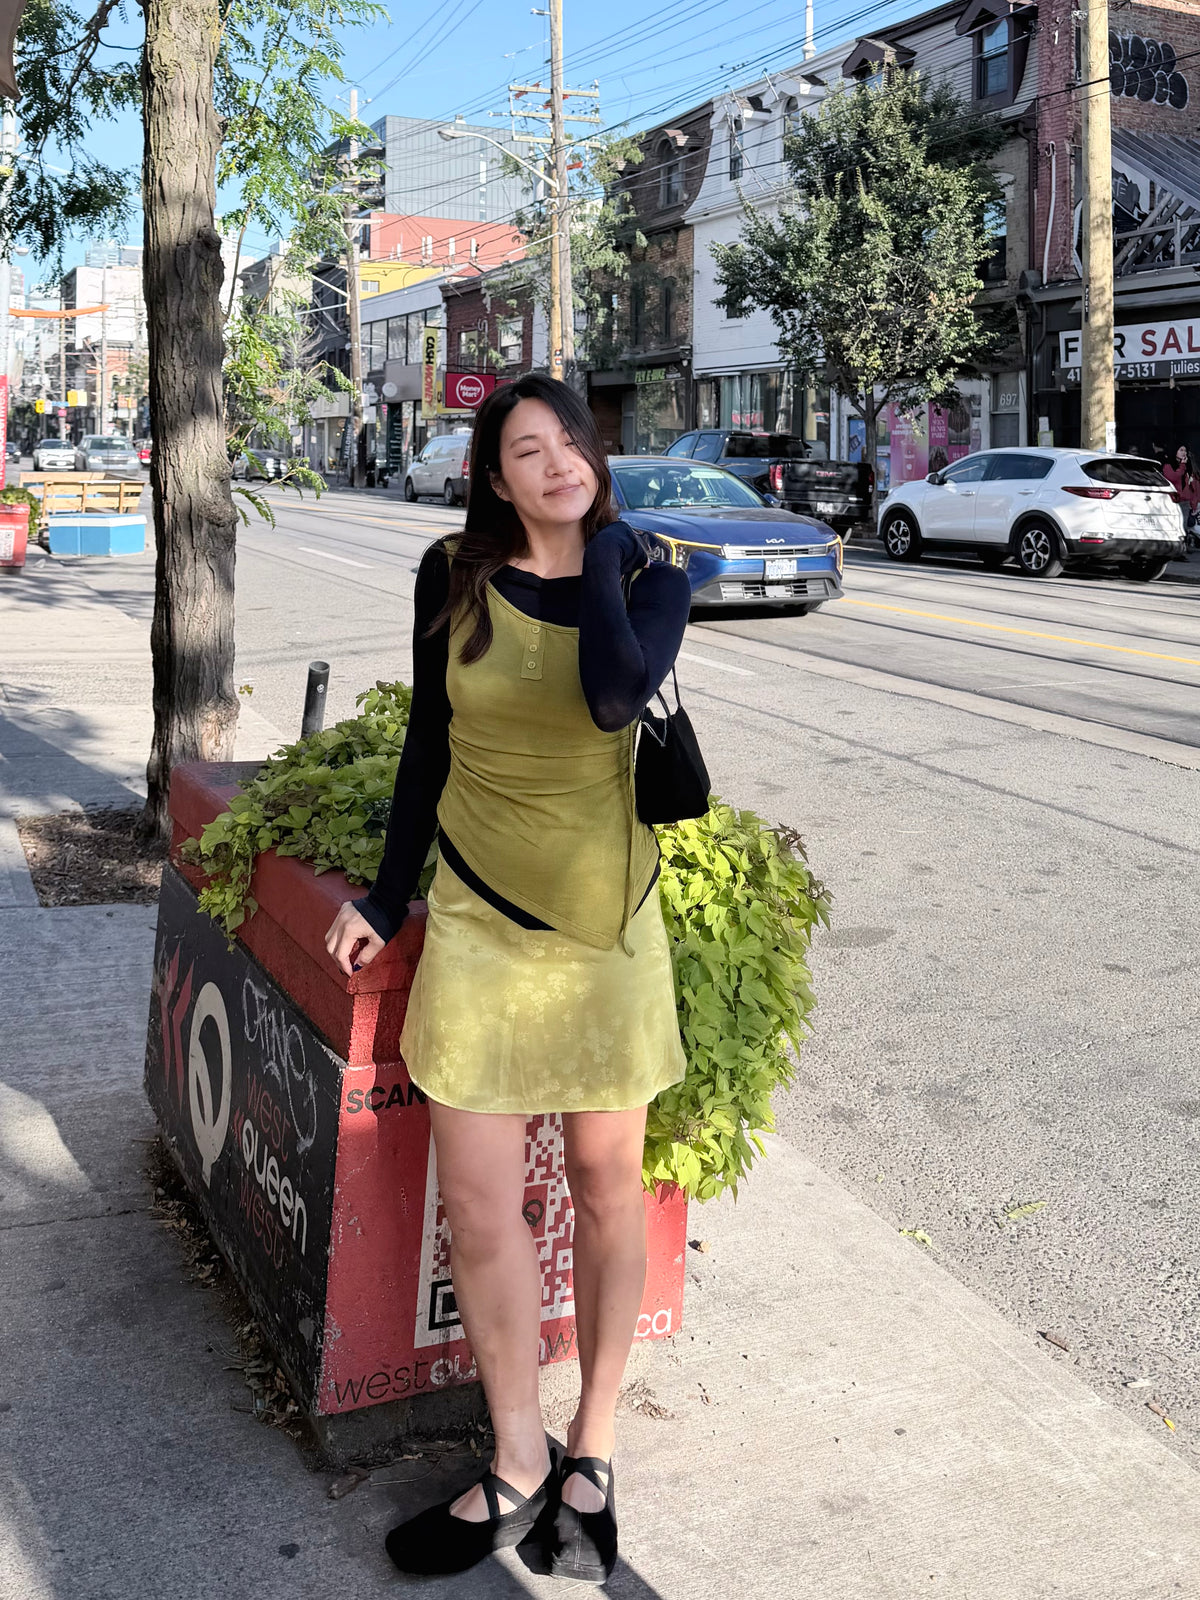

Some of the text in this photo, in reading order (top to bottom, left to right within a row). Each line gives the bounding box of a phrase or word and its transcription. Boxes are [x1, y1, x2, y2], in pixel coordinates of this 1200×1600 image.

[1064, 332, 1126, 363] FR
[460, 385, 481, 393] Money
[1000, 393, 1018, 407] 697
[815, 470, 842, 478] GMC
